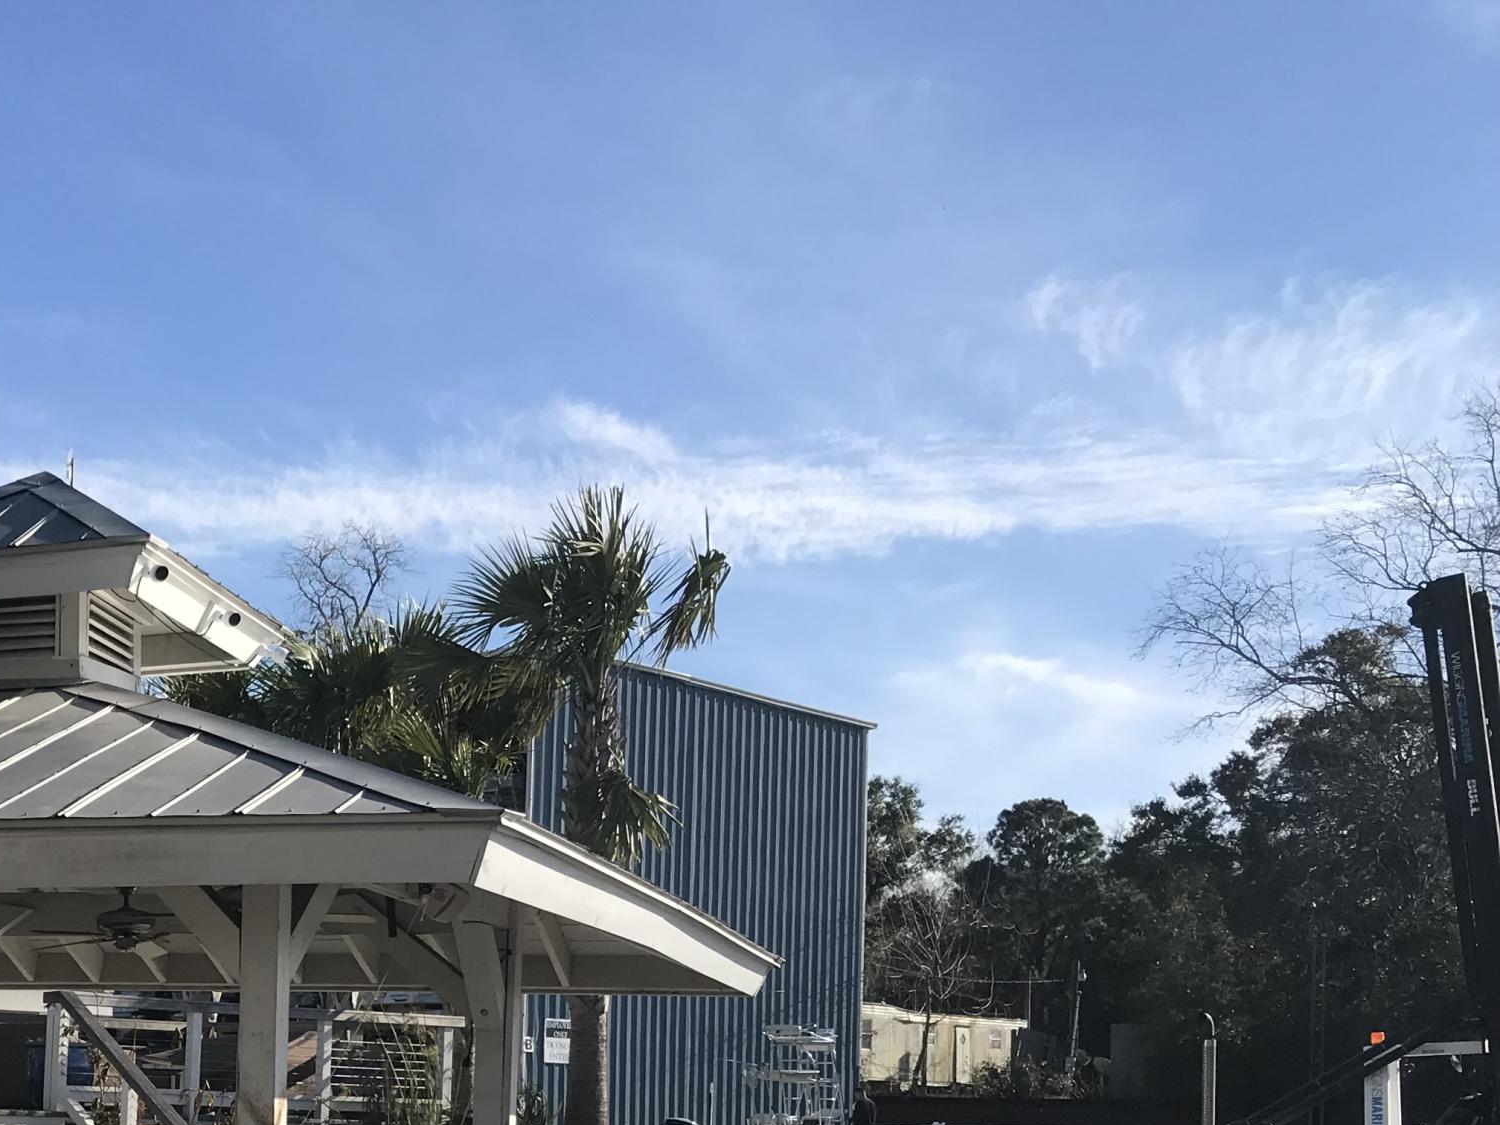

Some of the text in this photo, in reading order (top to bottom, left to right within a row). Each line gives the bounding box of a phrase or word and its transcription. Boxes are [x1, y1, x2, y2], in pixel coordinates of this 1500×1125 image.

[1466, 779, 1480, 817] BULL
[546, 1021, 571, 1029] EMPLOYE
[549, 1053, 569, 1061] ENTE
